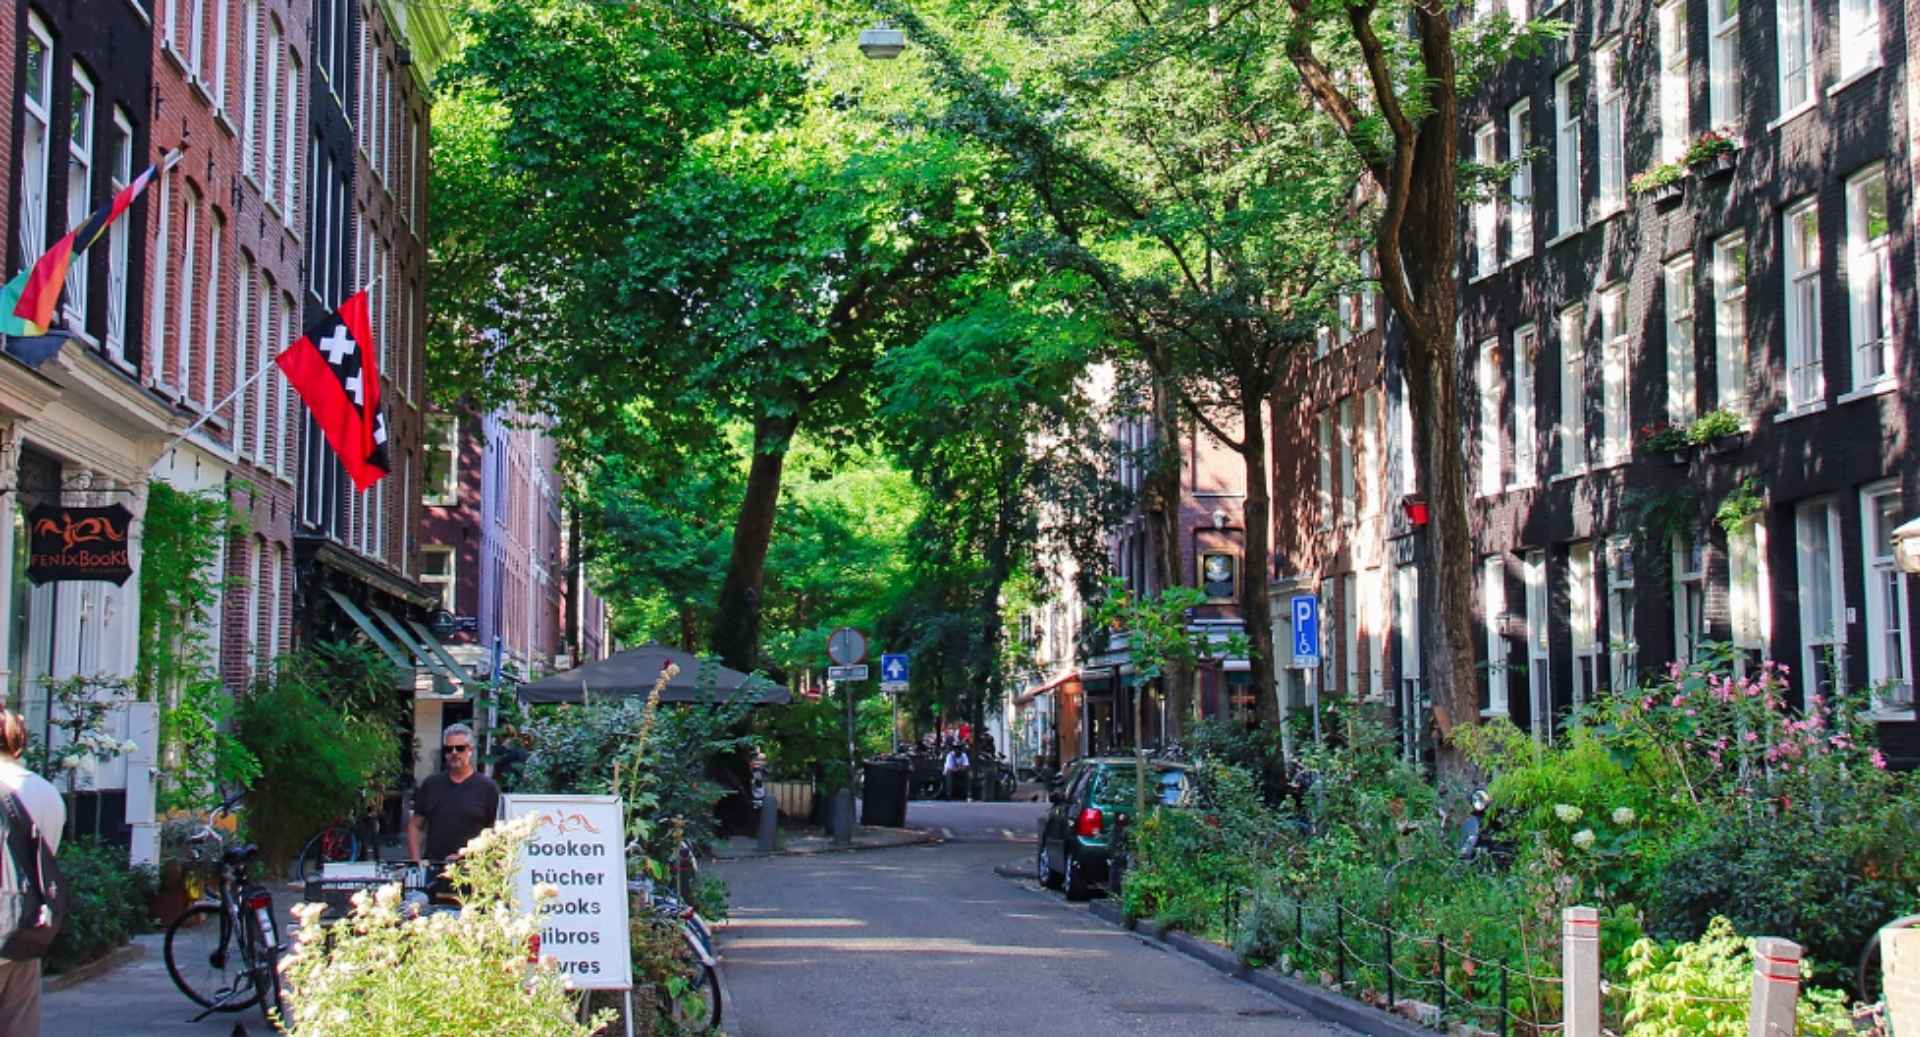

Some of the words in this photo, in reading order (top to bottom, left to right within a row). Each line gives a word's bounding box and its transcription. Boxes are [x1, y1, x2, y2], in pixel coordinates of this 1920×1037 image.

[1297, 601, 1311, 632] P
[528, 840, 605, 856] boeken
[531, 868, 605, 885] bücher
[542, 927, 600, 944] libros
